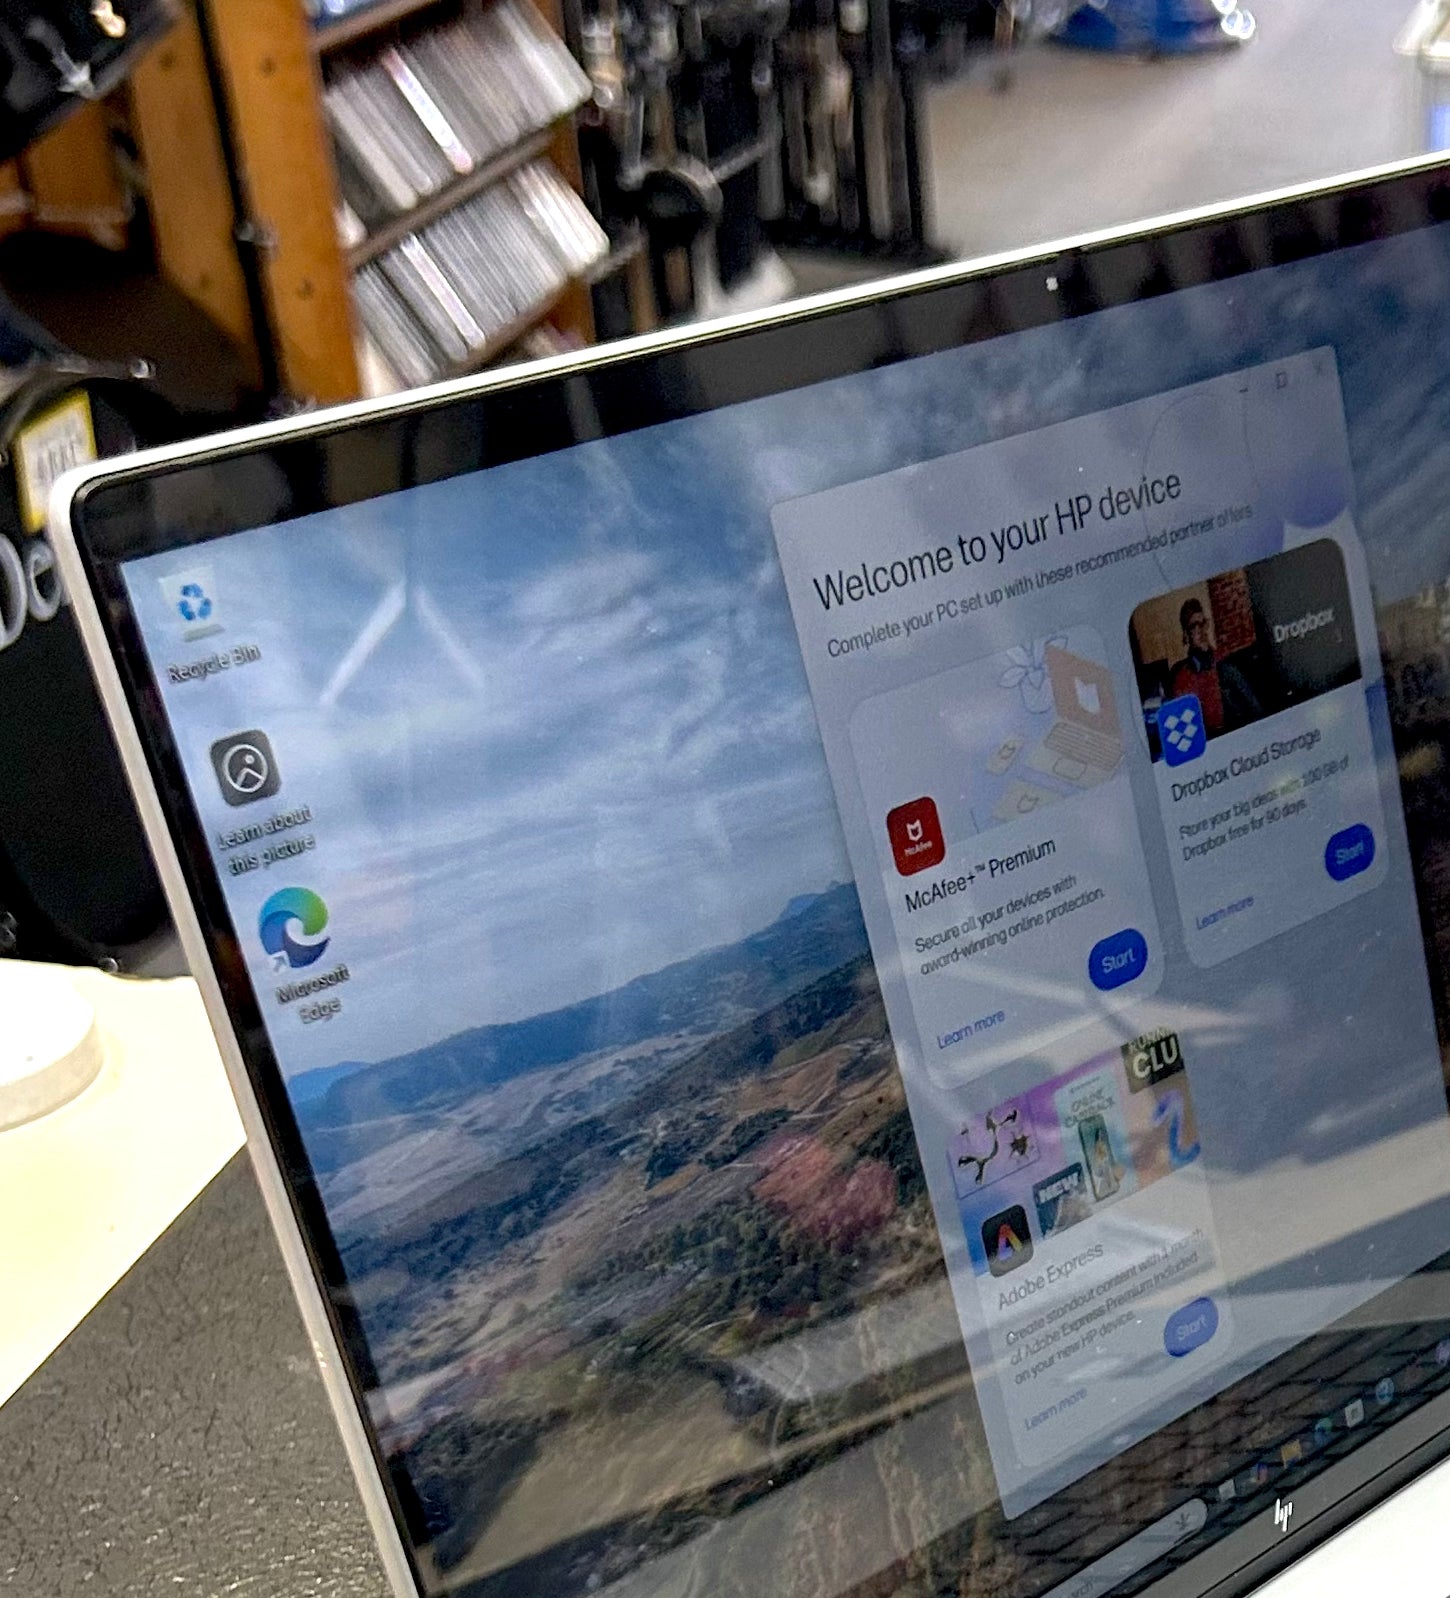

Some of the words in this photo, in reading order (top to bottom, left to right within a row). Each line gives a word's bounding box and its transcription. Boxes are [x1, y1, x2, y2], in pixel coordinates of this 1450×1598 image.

[813, 547, 953, 611] Welcome
[957, 534, 987, 566] to
[990, 512, 1049, 564] your
[1054, 494, 1093, 535] HP
[1099, 474, 1182, 521] device
[0, 532, 70, 650] De
[827, 623, 902, 658] Complete
[902, 609, 934, 637] your
[935, 601, 959, 623] PC
[960, 592, 984, 614] set
[984, 588, 1004, 611] up
[1004, 577, 1035, 601] with
[1035, 563, 1074, 589] these
[1075, 531, 1168, 575] recommended
[1168, 516, 1216, 547] partner
[1273, 607, 1336, 644] Dropbox
[167, 652, 230, 684] Recycle
[229, 644, 262, 668] Bin
[1171, 765, 1230, 802] Dropbox
[1229, 749, 1270, 777] Cloud
[1270, 728, 1323, 761] Storage
[218, 824, 264, 851] Learn
[262, 804, 314, 835] about
[1182, 832, 1228, 862] Dropbox
[228, 853, 260, 878] this
[262, 833, 316, 869] picture
[988, 839, 1058, 879] Premium
[1334, 840, 1366, 866] Start
[914, 924, 961, 954] Secure
[960, 916, 978, 934] all
[977, 906, 1005, 931] your
[1005, 887, 1053, 915] devices
[1052, 873, 1078, 893] with
[920, 929, 1008, 976] award-winning
[1007, 912, 1045, 938] online
[1100, 947, 1138, 975] Start
[275, 963, 351, 1004] Microsoft
[298, 997, 343, 1026] Edge
[936, 1025, 974, 1050] Learn
[974, 1009, 1007, 1034] more
[1131, 1035, 1180, 1080] CLU
[998, 1273, 1046, 1311] Adobe
[1046, 1243, 1105, 1287] Express
[1005, 1317, 1046, 1347] Create
[1046, 1289, 1095, 1324] standout
[1095, 1269, 1140, 1297] content
[1023, 1329, 1063, 1361] Adobe
[1061, 1307, 1107, 1338] Express
[1106, 1279, 1155, 1313] Premium
[1153, 1251, 1199, 1288] included
[1014, 1366, 1032, 1386] on
[1031, 1351, 1056, 1378] your
[1055, 1341, 1079, 1363] new
[1079, 1329, 1099, 1350] HP
[1024, 1405, 1058, 1431] Learn
[1057, 1386, 1089, 1411] more
